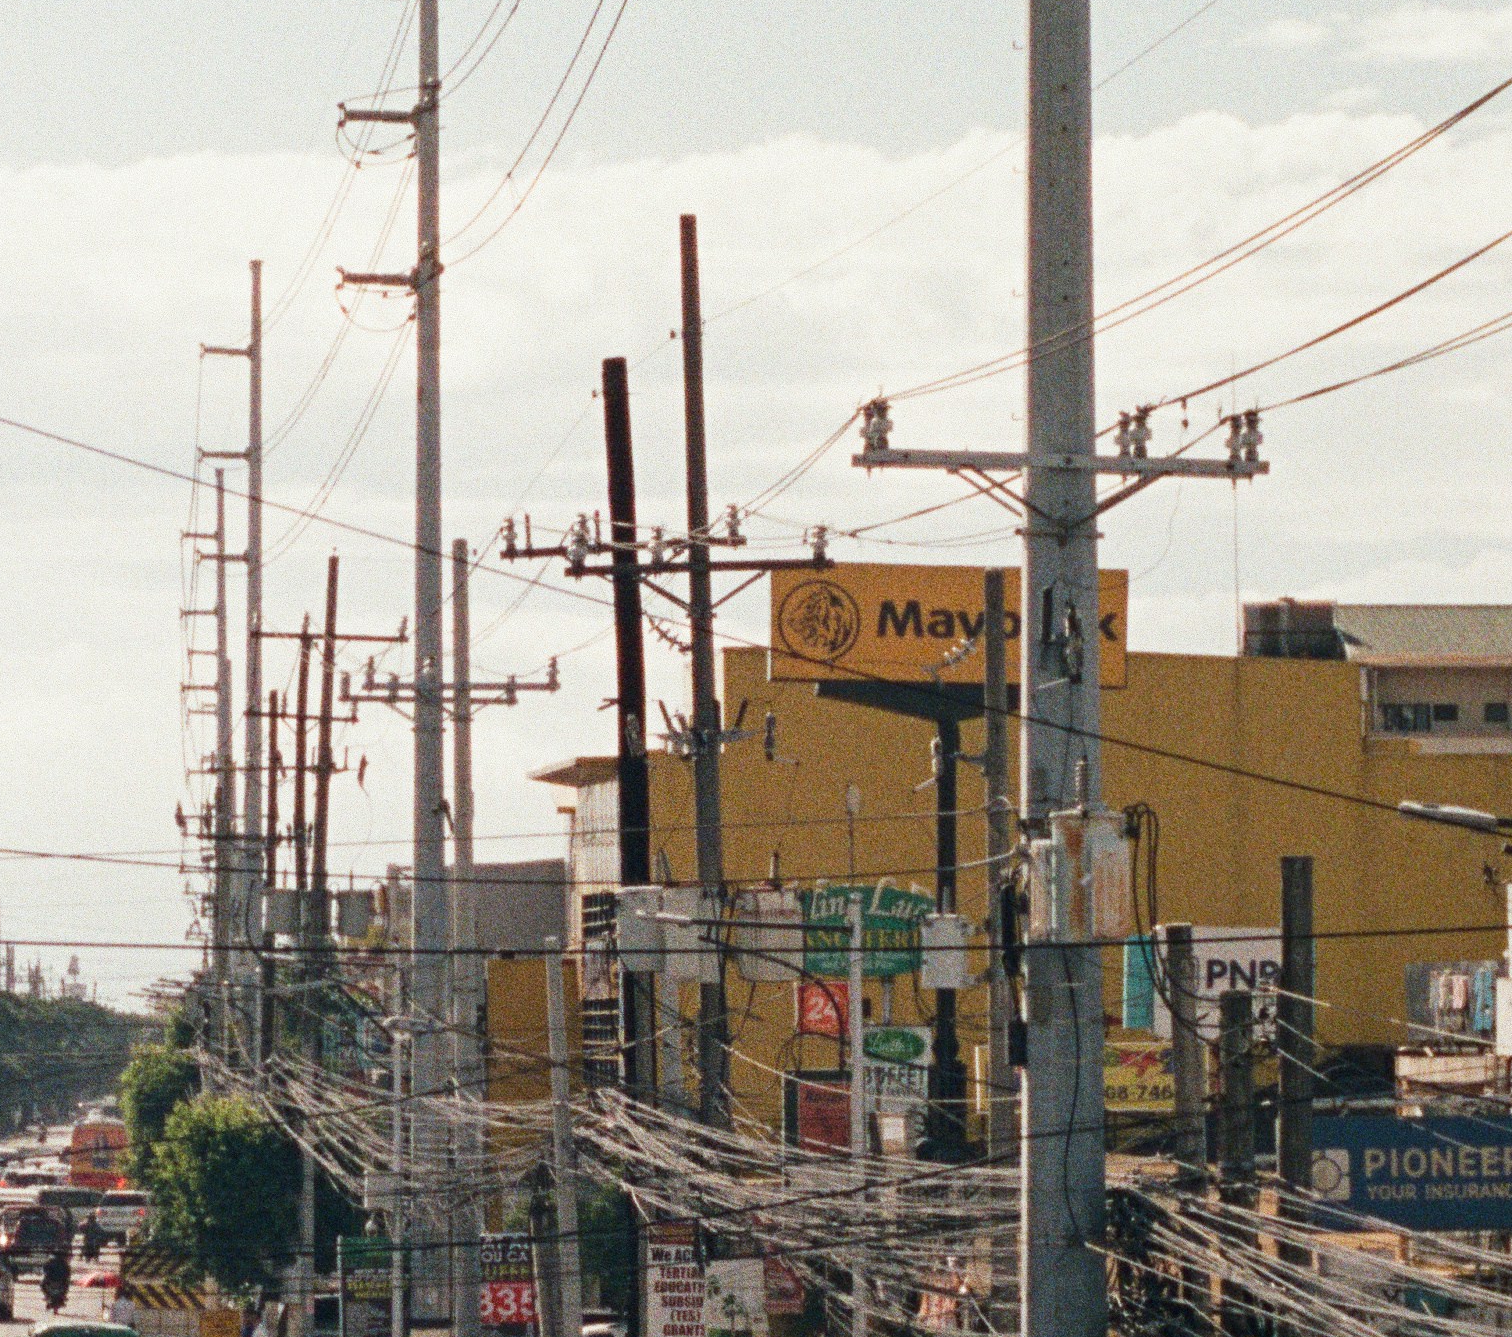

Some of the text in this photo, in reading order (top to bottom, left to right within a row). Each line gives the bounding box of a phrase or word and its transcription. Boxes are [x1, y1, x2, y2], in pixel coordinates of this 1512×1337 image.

[1367, 1184, 1418, 1201] YOUR
[480, 1251, 529, 1263] OU CA
